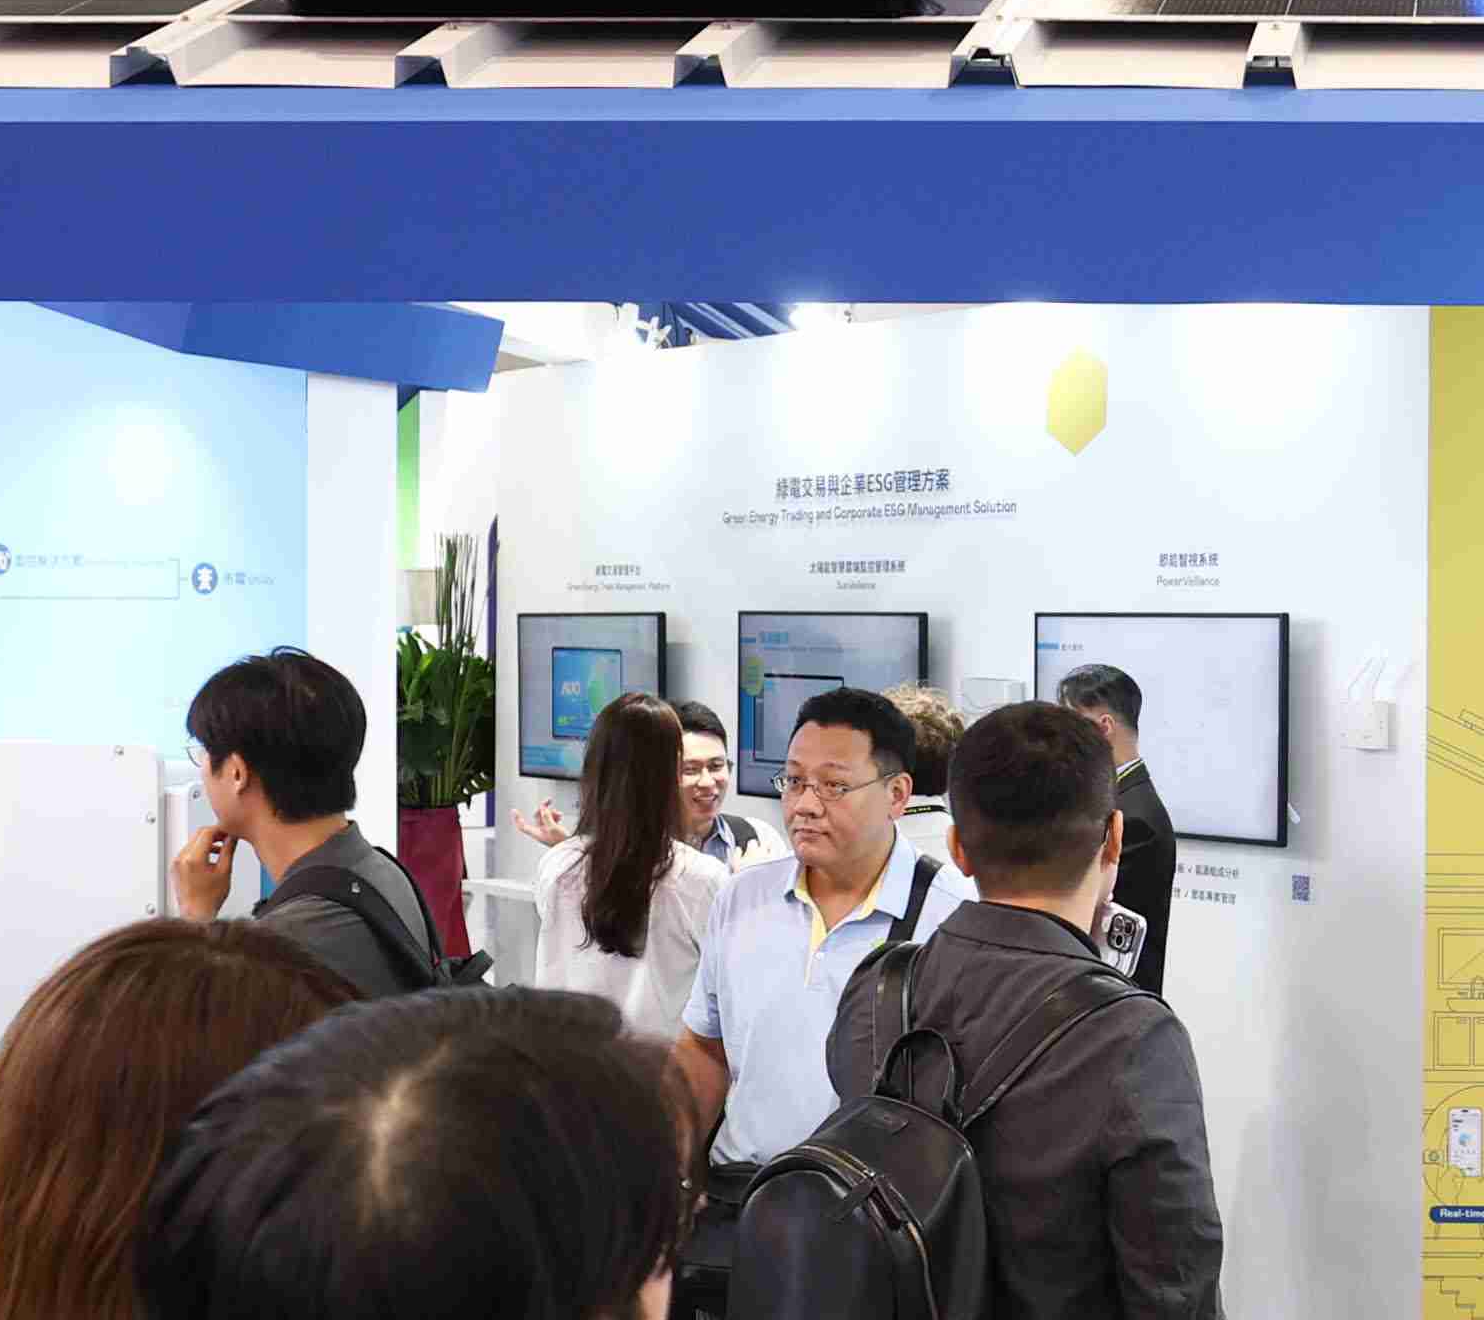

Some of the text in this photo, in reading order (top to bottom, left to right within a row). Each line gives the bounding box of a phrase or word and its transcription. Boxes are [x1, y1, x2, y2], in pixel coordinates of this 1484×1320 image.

[776, 469, 952, 499] 綠電交易與企業ESG管理方案
[749, 509, 779, 525] Energy
[781, 507, 814, 523] Trading
[816, 507, 831, 520] and
[833, 504, 883, 522] Corporate
[883, 502, 905, 518] ESG
[907, 501, 971, 519] Management
[973, 499, 1017, 514] Solution
